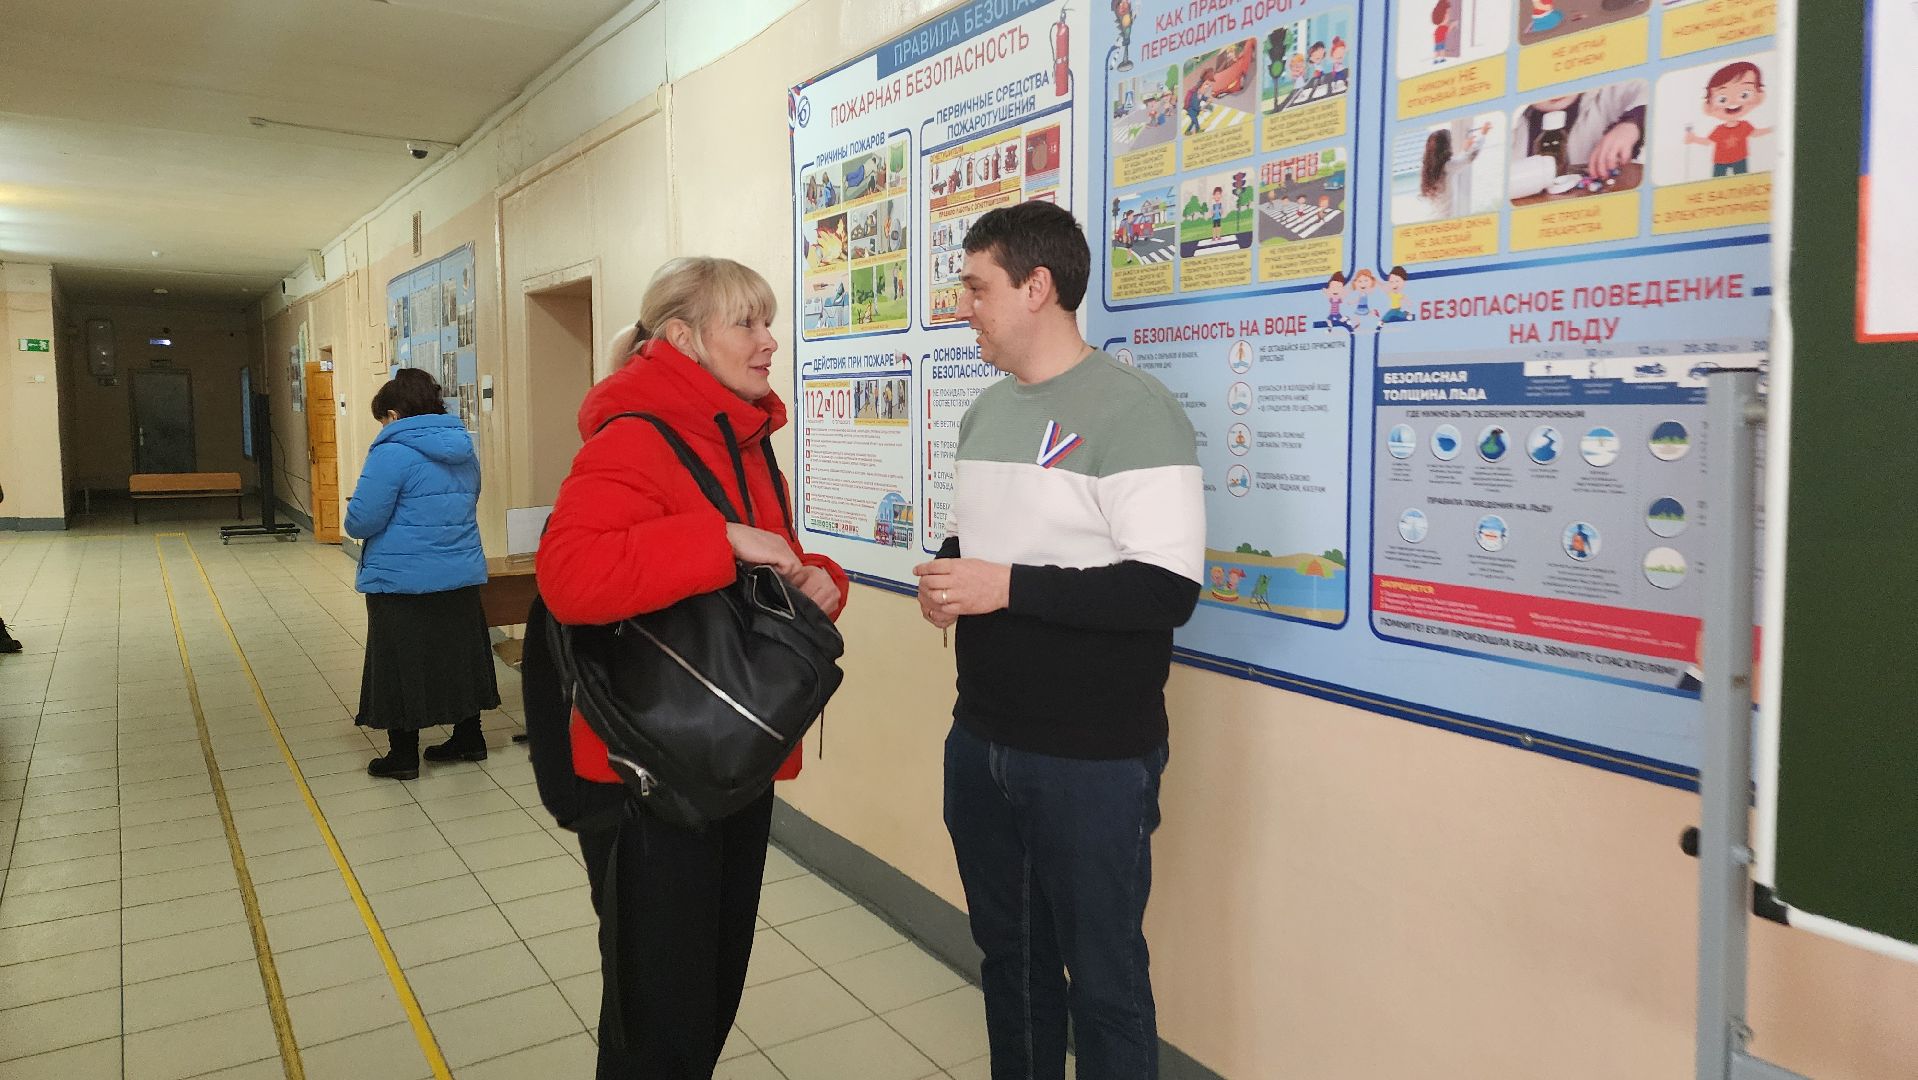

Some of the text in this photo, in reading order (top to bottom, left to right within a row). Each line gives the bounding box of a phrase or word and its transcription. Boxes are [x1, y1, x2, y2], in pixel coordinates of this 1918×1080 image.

[894, 0, 1036, 66] ПРАВИЛА БЕЗОПА
[1141, 0, 1306, 62] ПЕРЕХОДИТЬ ДОРО
[1155, 6, 1184, 33] КАК
[830, 25, 1030, 128] ПОЖАРНАЯ БЕЗОПАСНОСТЬ
[1459, 66, 1478, 81] НЕ
[936, 70, 1050, 125] ПЕРВИЧНЫЕ СРЕДСТВА
[947, 95, 1036, 140] ПОЖАРОТУШЕНИЯ
[816, 132, 885, 168] ПРИЧИНЫ ПОЖАРОВ
[1420, 274, 1745, 321] БЕЗОПАСНОЕ ПОВЕДЕНИЕ
[1134, 315, 1308, 345] БЕЗОПАСНОСТЬ НА ВОДЕ
[1510, 317, 1621, 344] НА ЛЬДУ
[813, 353, 894, 372] ДЕЙСТВИЯ ПРИ ПОЖАРЕ
[933, 345, 982, 362] ОСНОВНЫЕ
[932, 362, 1001, 379] БЕЗОПАСНОСТИ
[1383, 370, 1468, 384] БЕЗОПАСНАЯ
[805, 389, 851, 418] 112 101
[1382, 387, 1488, 402] ТОЛЩИНА ЛЬДА
